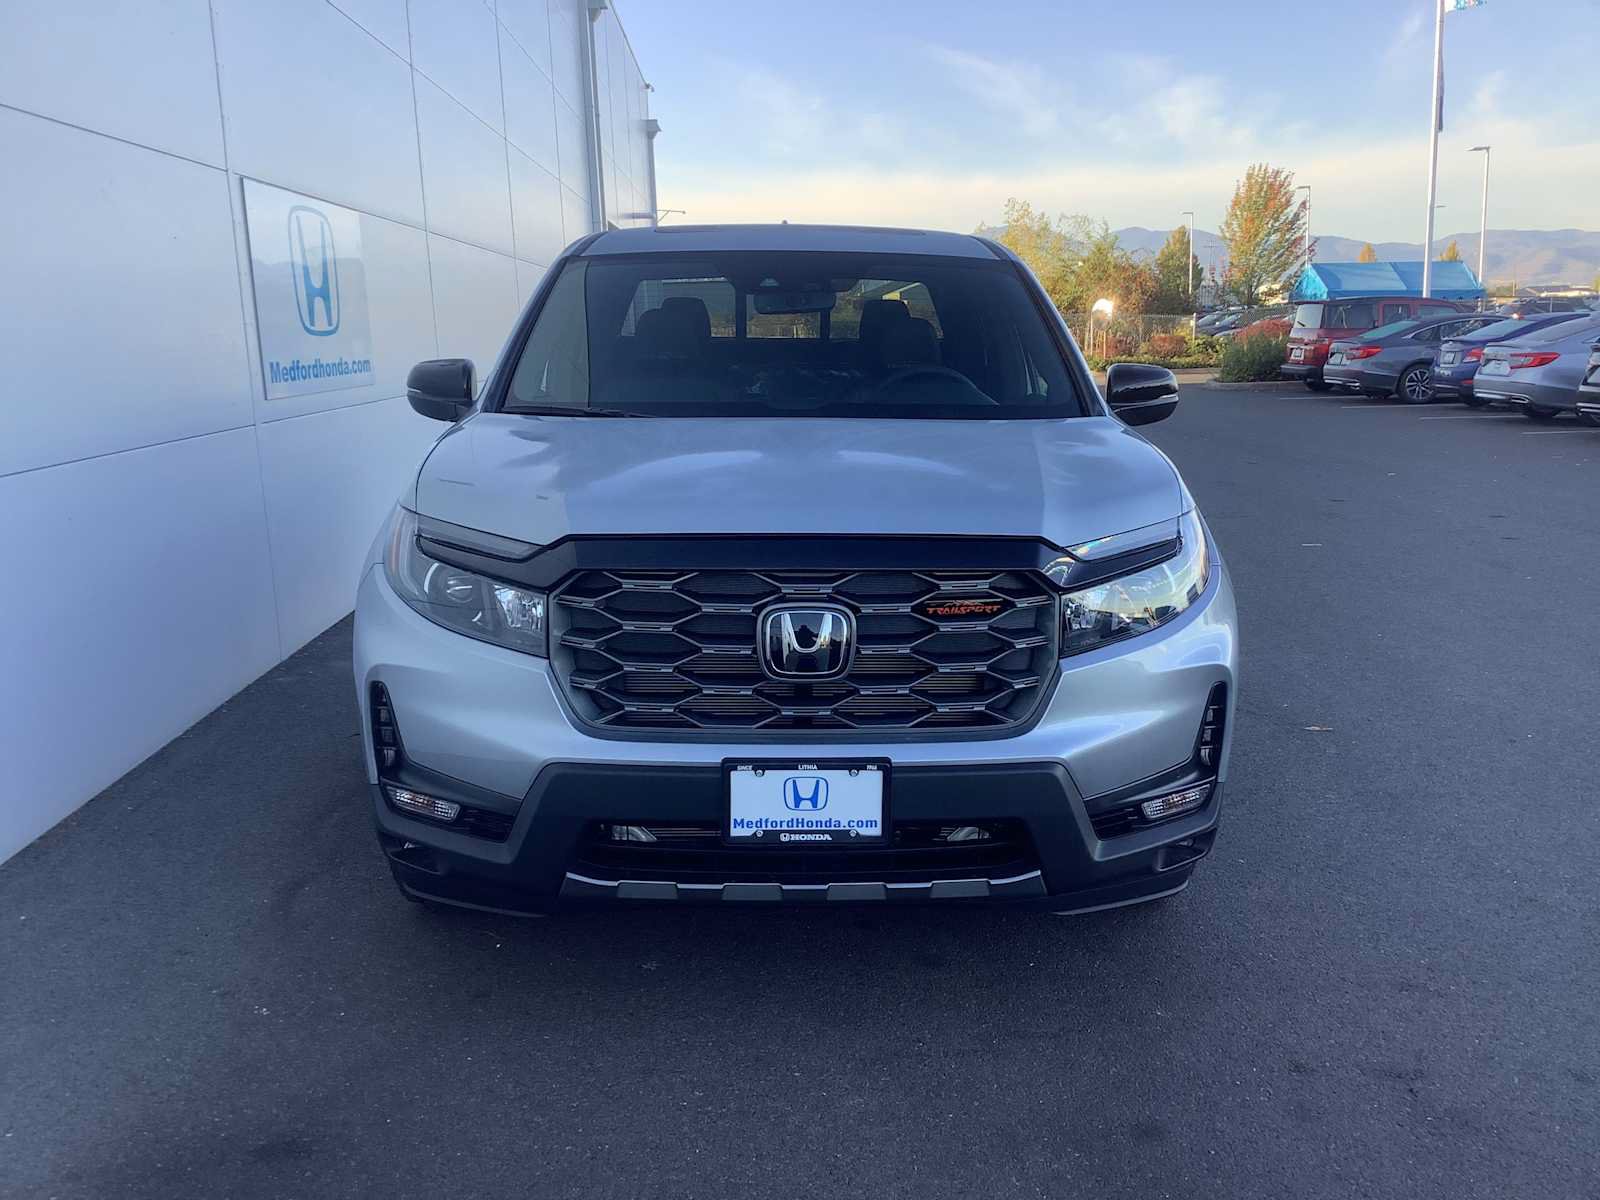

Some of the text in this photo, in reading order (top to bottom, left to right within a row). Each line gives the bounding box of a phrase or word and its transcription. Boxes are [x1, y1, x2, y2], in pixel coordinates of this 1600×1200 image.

[269, 358, 371, 383] Medfordhonda.com
[733, 818, 878, 829] MedfordHonda.com
[789, 833, 832, 841] HONDA
